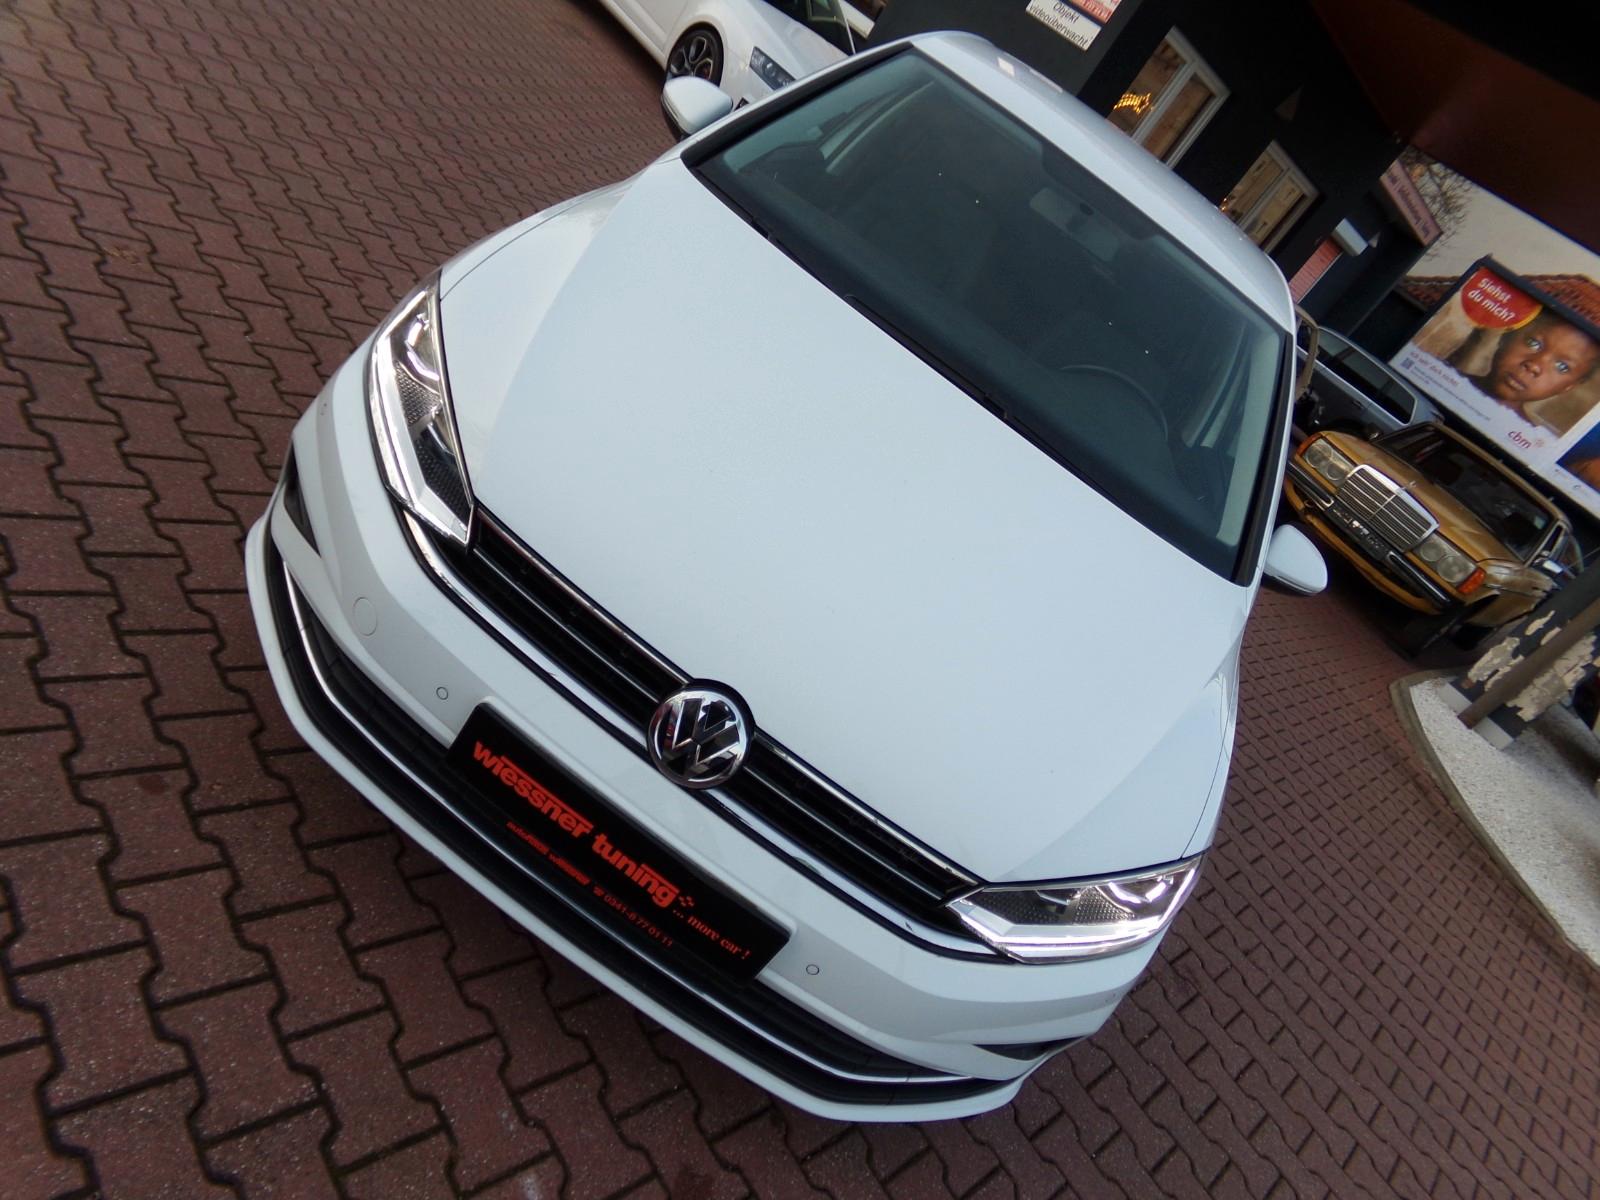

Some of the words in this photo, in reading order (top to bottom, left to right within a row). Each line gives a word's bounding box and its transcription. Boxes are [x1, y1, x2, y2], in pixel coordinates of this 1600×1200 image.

[1053, 1, 1080, 24] Objekt
[1478, 277, 1511, 303] Siehst
[1468, 289, 1484, 303] du
[1483, 296, 1516, 322] mich?
[1507, 429, 1532, 449] cbm
[472, 741, 594, 839] wiessner
[591, 833, 680, 909] tuning
[687, 915, 720, 941] more
[719, 938, 742, 956] car
